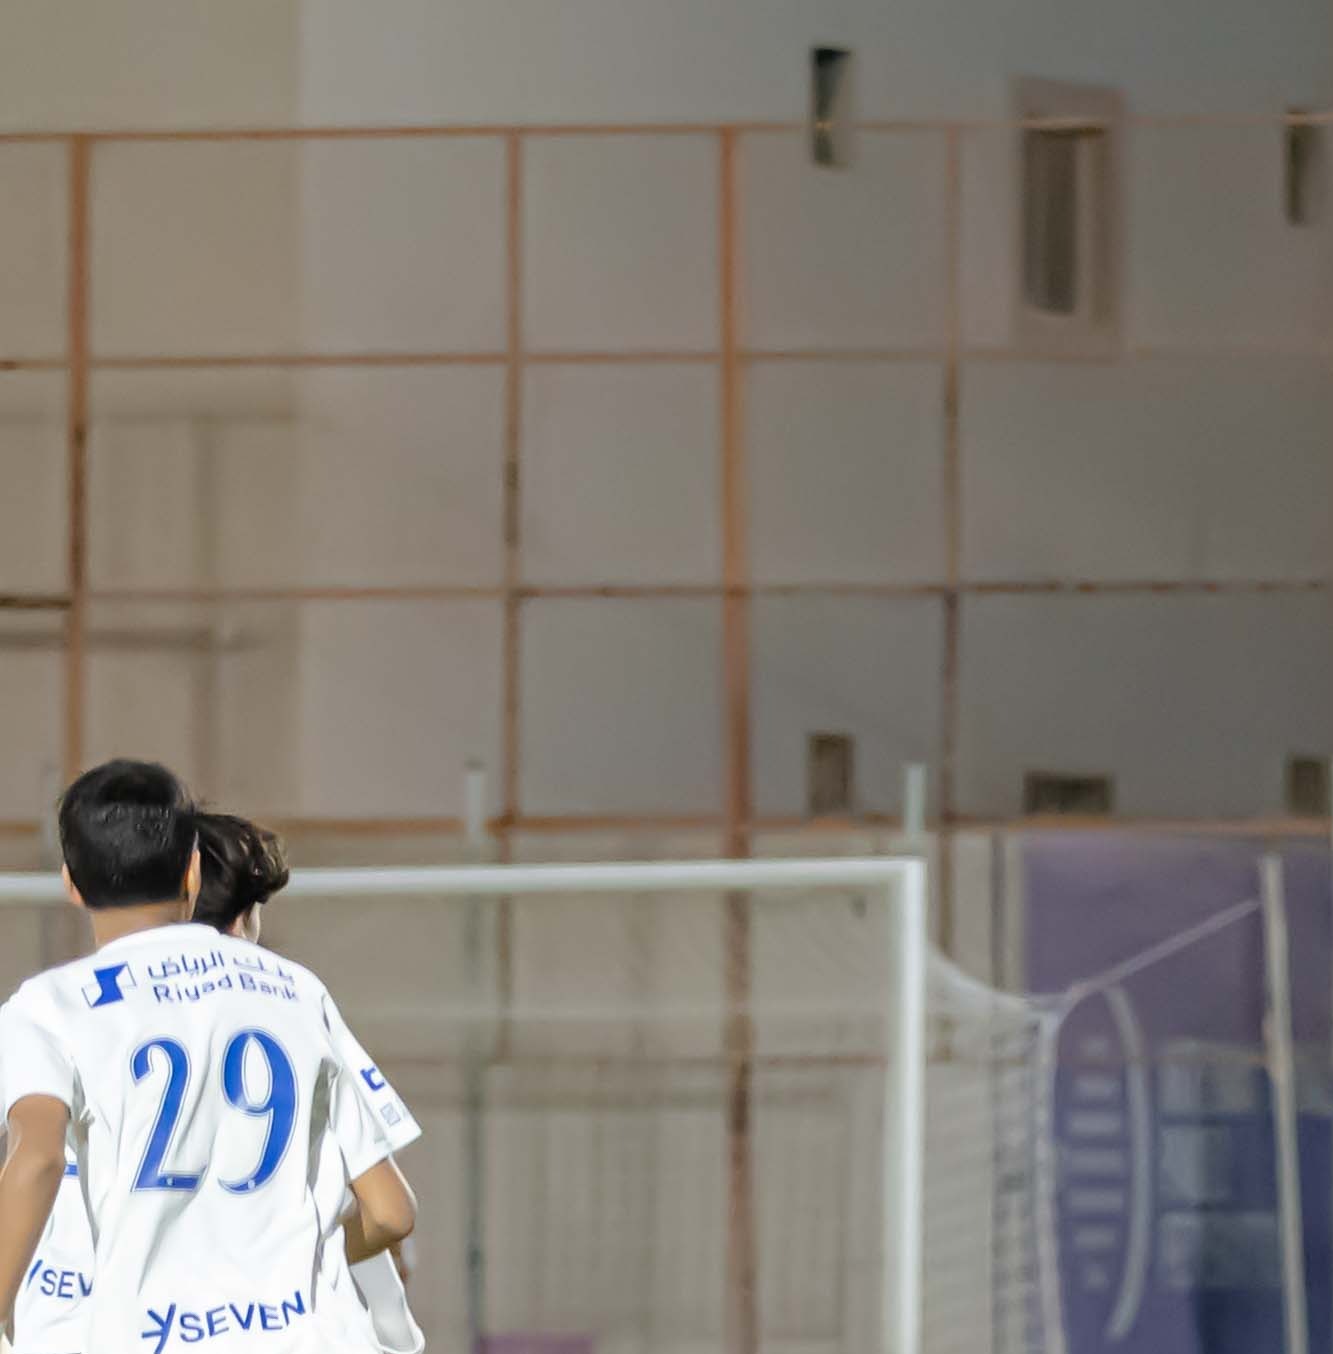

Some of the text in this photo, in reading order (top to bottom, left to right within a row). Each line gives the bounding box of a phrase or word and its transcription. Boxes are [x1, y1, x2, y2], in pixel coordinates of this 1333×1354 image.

[153, 973, 299, 1003] Riyad Bank
[130, 1026, 298, 1194] 29
